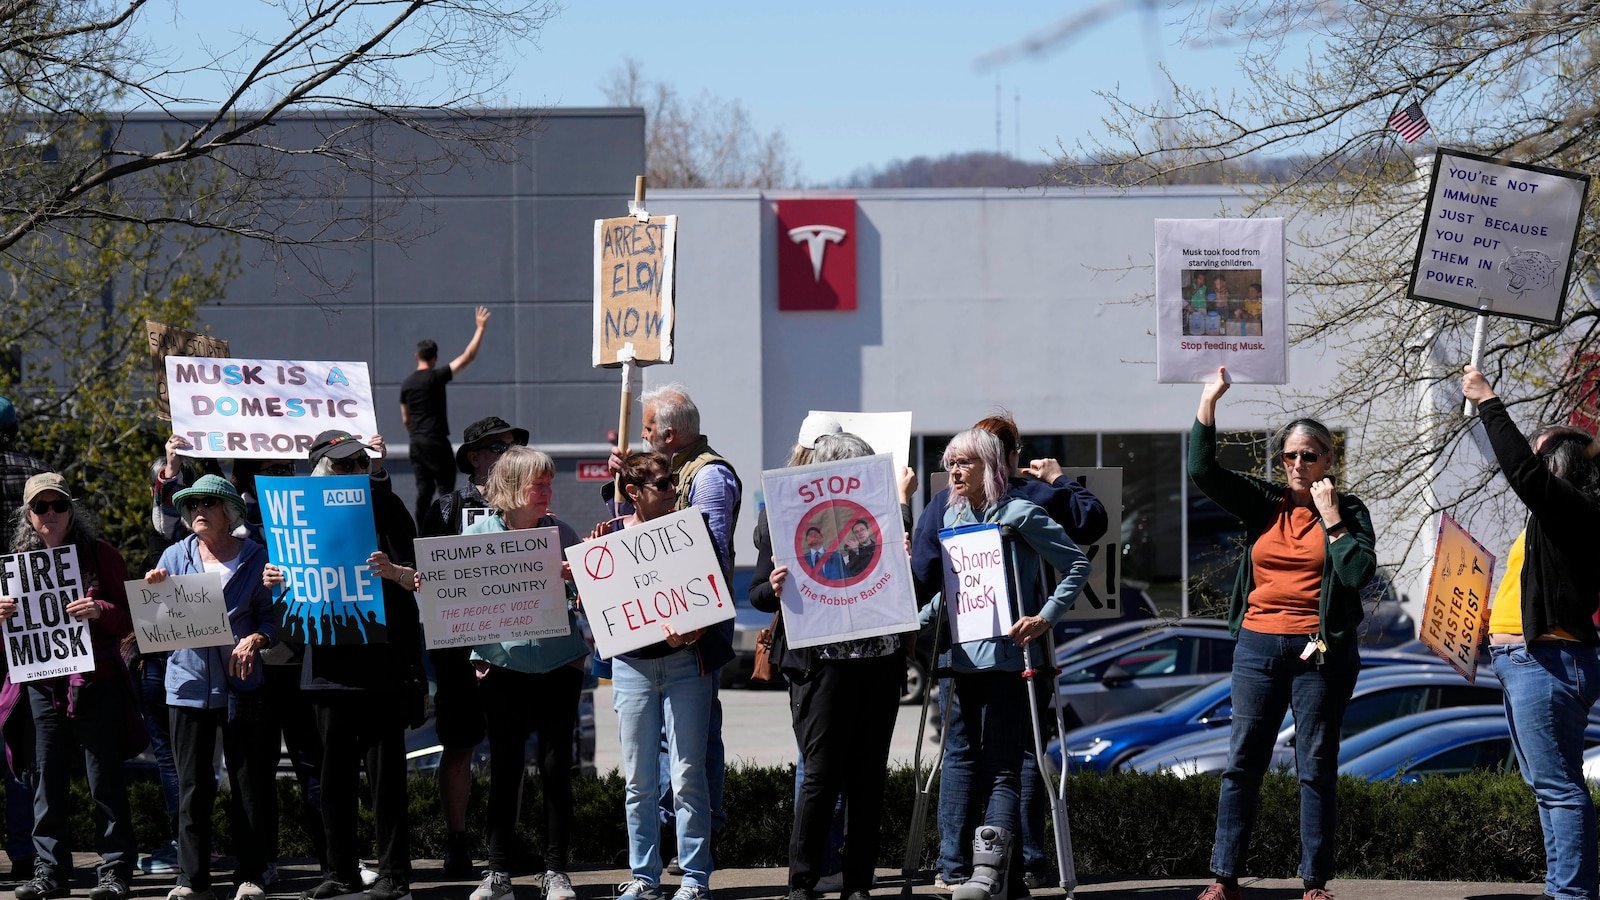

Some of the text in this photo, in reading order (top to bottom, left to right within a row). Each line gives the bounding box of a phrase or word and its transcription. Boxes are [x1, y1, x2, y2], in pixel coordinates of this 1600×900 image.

[1449, 168, 1539, 194] YOU'RE NOT
[1443, 188, 1499, 208] IMMUNE
[1439, 209, 1549, 236] JUST BECAUSE
[603, 223, 668, 259] ARREST
[1182, 248, 1260, 256] Musk took food from
[1436, 229, 1501, 250] YOU PUT
[1188, 259, 1254, 268] starving children.
[1431, 249, 1493, 270] THEM IN
[611, 256, 667, 300] ELON
[1426, 270, 1477, 289] POWER.
[605, 306, 665, 347] NOW
[1181, 341, 1265, 351] Stop feeding Musk.
[176, 363, 350, 386] MUSK IS A
[191, 395, 358, 418] DOMESTIC
[187, 431, 362, 452] TERROR
[326, 491, 363, 504] ACLU
[798, 475, 861, 503] STOP
[265, 489, 307, 527] WE
[270, 527, 319, 565] THE
[431, 537, 549, 562] tRUMP & fELON
[621, 519, 694, 564] VOTES
[0, 547, 76, 596] FIRE
[420, 561, 544, 582] ARE DESTROYING
[949, 546, 1001, 575] Shame
[279, 564, 374, 603] PEOPLE
[437, 579, 548, 599] OUR COUNTRY
[633, 570, 662, 589] FOR
[800, 571, 891, 606] The Robber Barons
[6, 588, 83, 634] ELON
[166, 608, 185, 618] the
[441, 608, 460, 620] THE
[511, 599, 540, 612] VOICE
[602, 574, 723, 637] FELONS!
[1429, 594, 1446, 640] FAST
[142, 613, 228, 643] White House!
[452, 615, 533, 633] WILL BE HEARD
[1444, 586, 1465, 652] FASTER
[1458, 588, 1479, 665] FASCIST
[9, 626, 88, 667] MUSK
[433, 634, 462, 646] brought
[463, 635, 476, 644] you
[478, 633, 487, 642] by
[488, 632, 500, 640] the
[511, 630, 522, 638] 1st
[523, 627, 567, 637] Amendment
[34, 665, 78, 678] INDIVISIBLE
